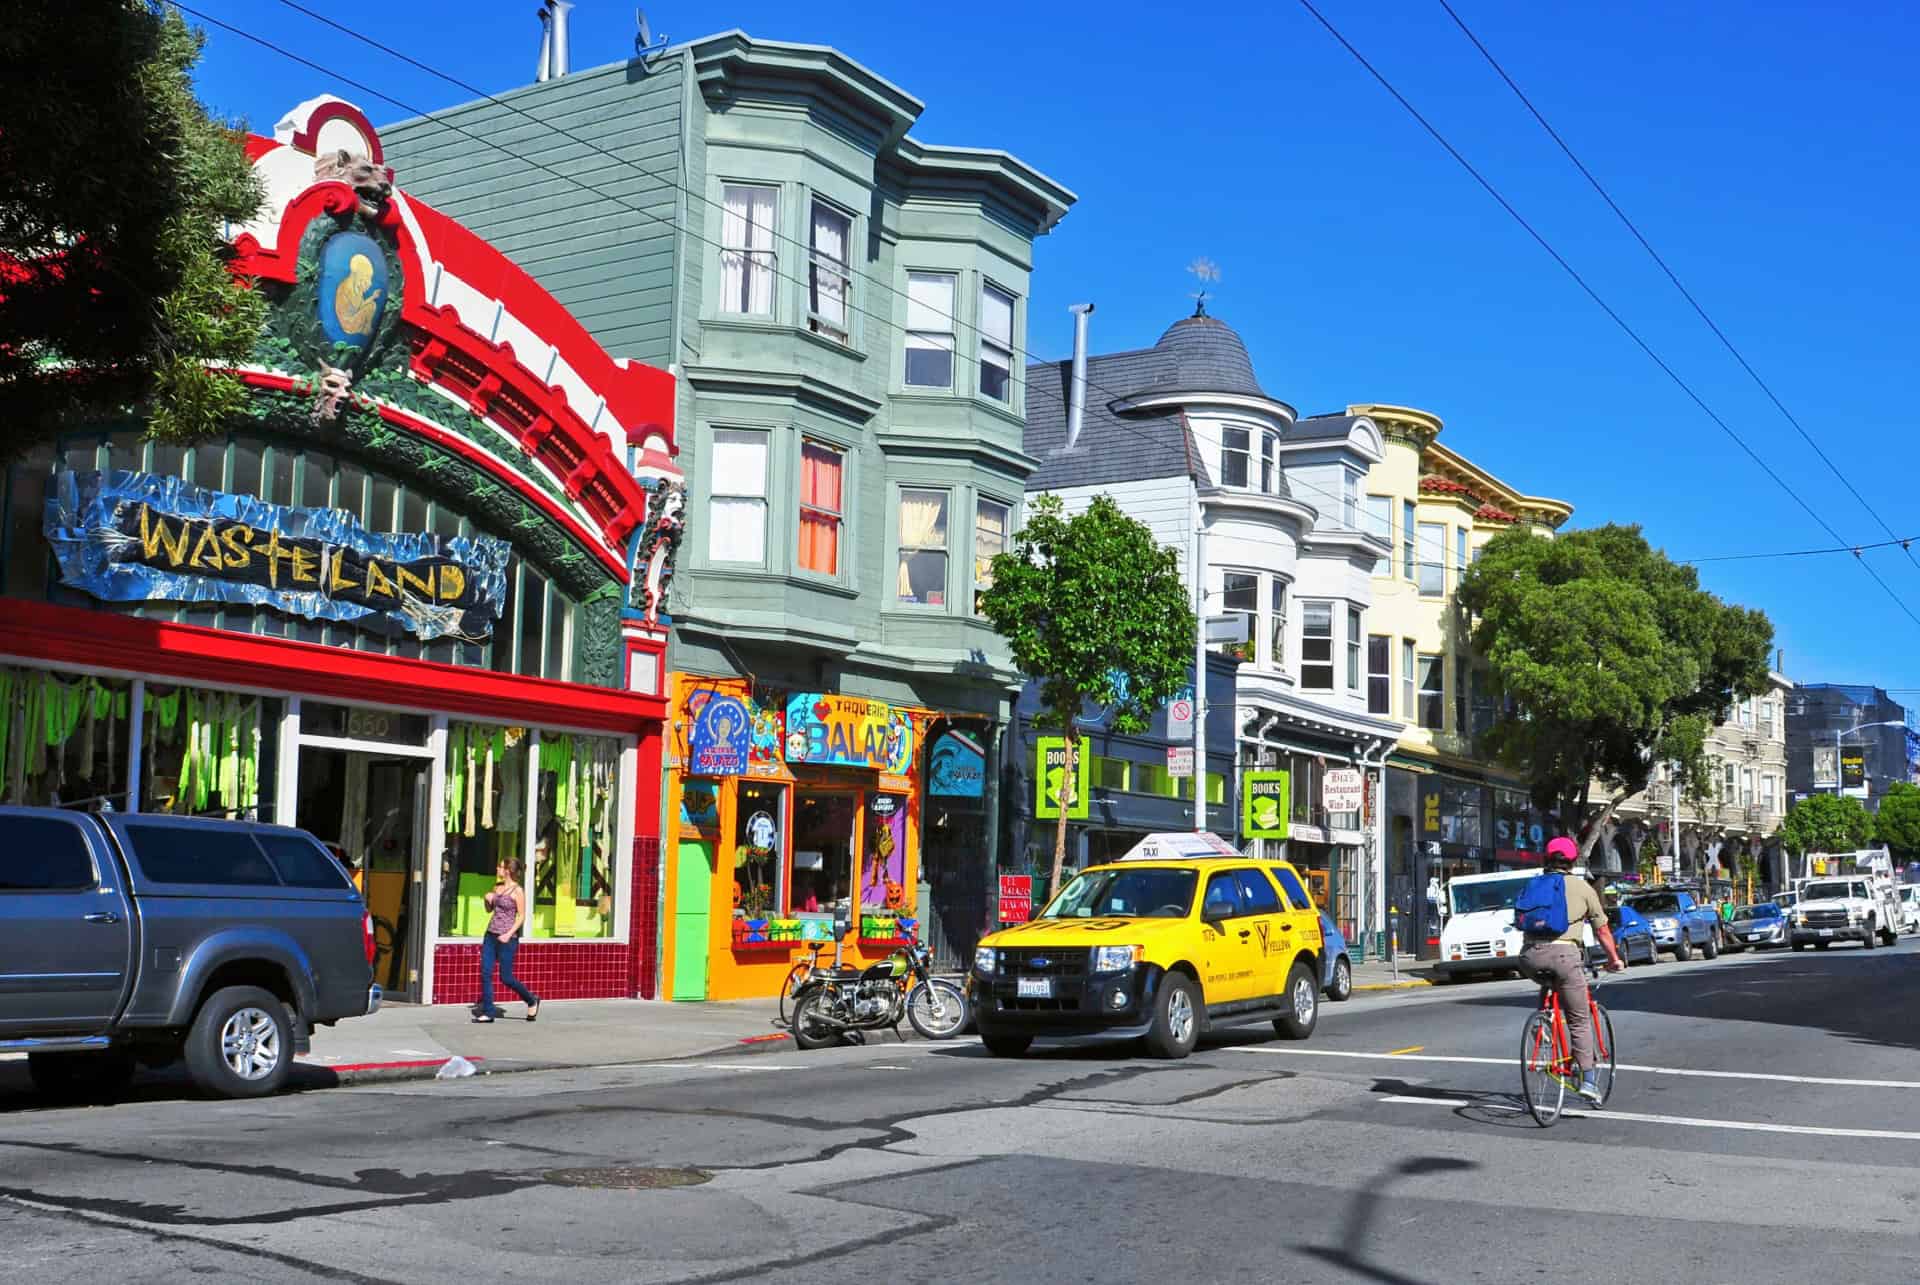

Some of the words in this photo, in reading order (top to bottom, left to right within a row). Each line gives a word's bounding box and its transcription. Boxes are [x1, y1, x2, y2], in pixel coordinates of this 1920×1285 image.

[141, 502, 467, 600] WASTELAND
[836, 701, 886, 717] TAQUERIA
[1047, 752, 1080, 765] BOOS
[1252, 783, 1281, 794] BOOKS
[1325, 784, 1360, 794] Restaurant
[1328, 800, 1344, 809] Wine
[1346, 800, 1358, 809] Bar
[1143, 847, 1159, 857] TAXI
